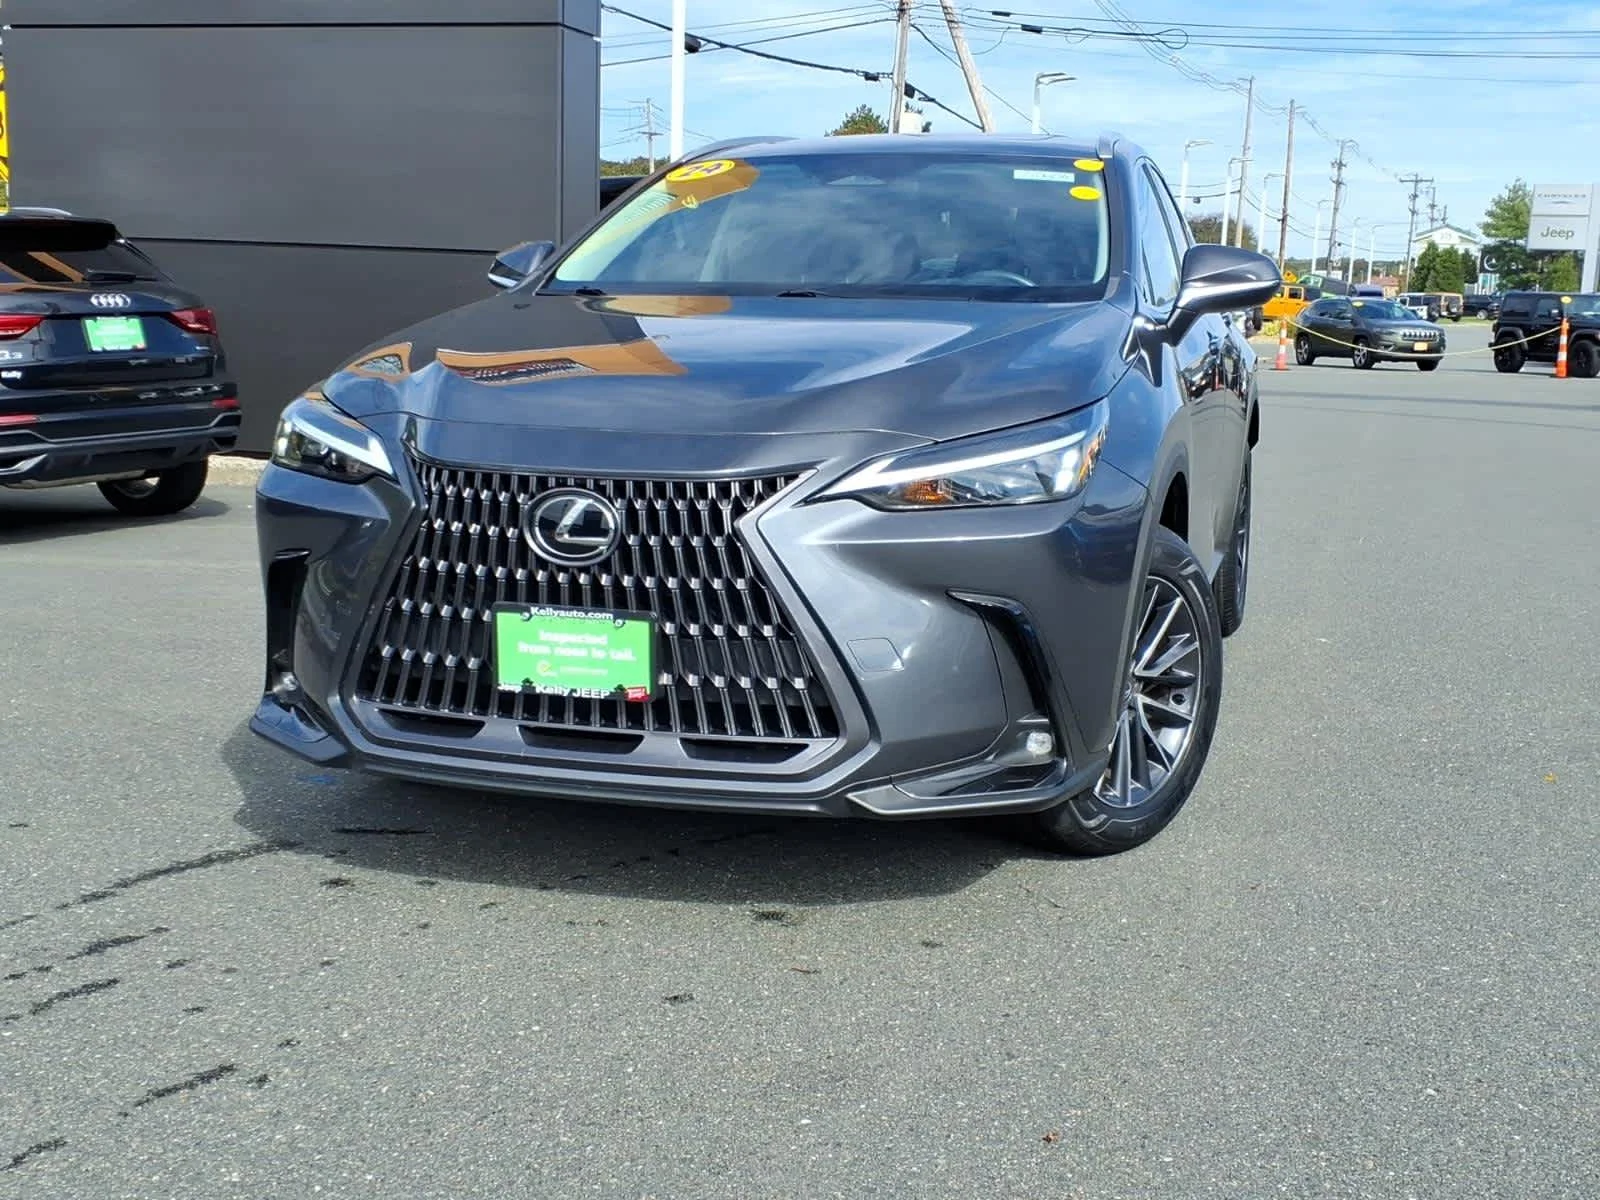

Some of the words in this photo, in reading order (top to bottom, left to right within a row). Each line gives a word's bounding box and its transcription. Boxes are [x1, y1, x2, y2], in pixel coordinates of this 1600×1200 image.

[1540, 225, 1575, 240] Jeep
[530, 606, 614, 620] Kellyauto.com
[535, 684, 571, 697] Kelly
[572, 687, 611, 699] JEEP
